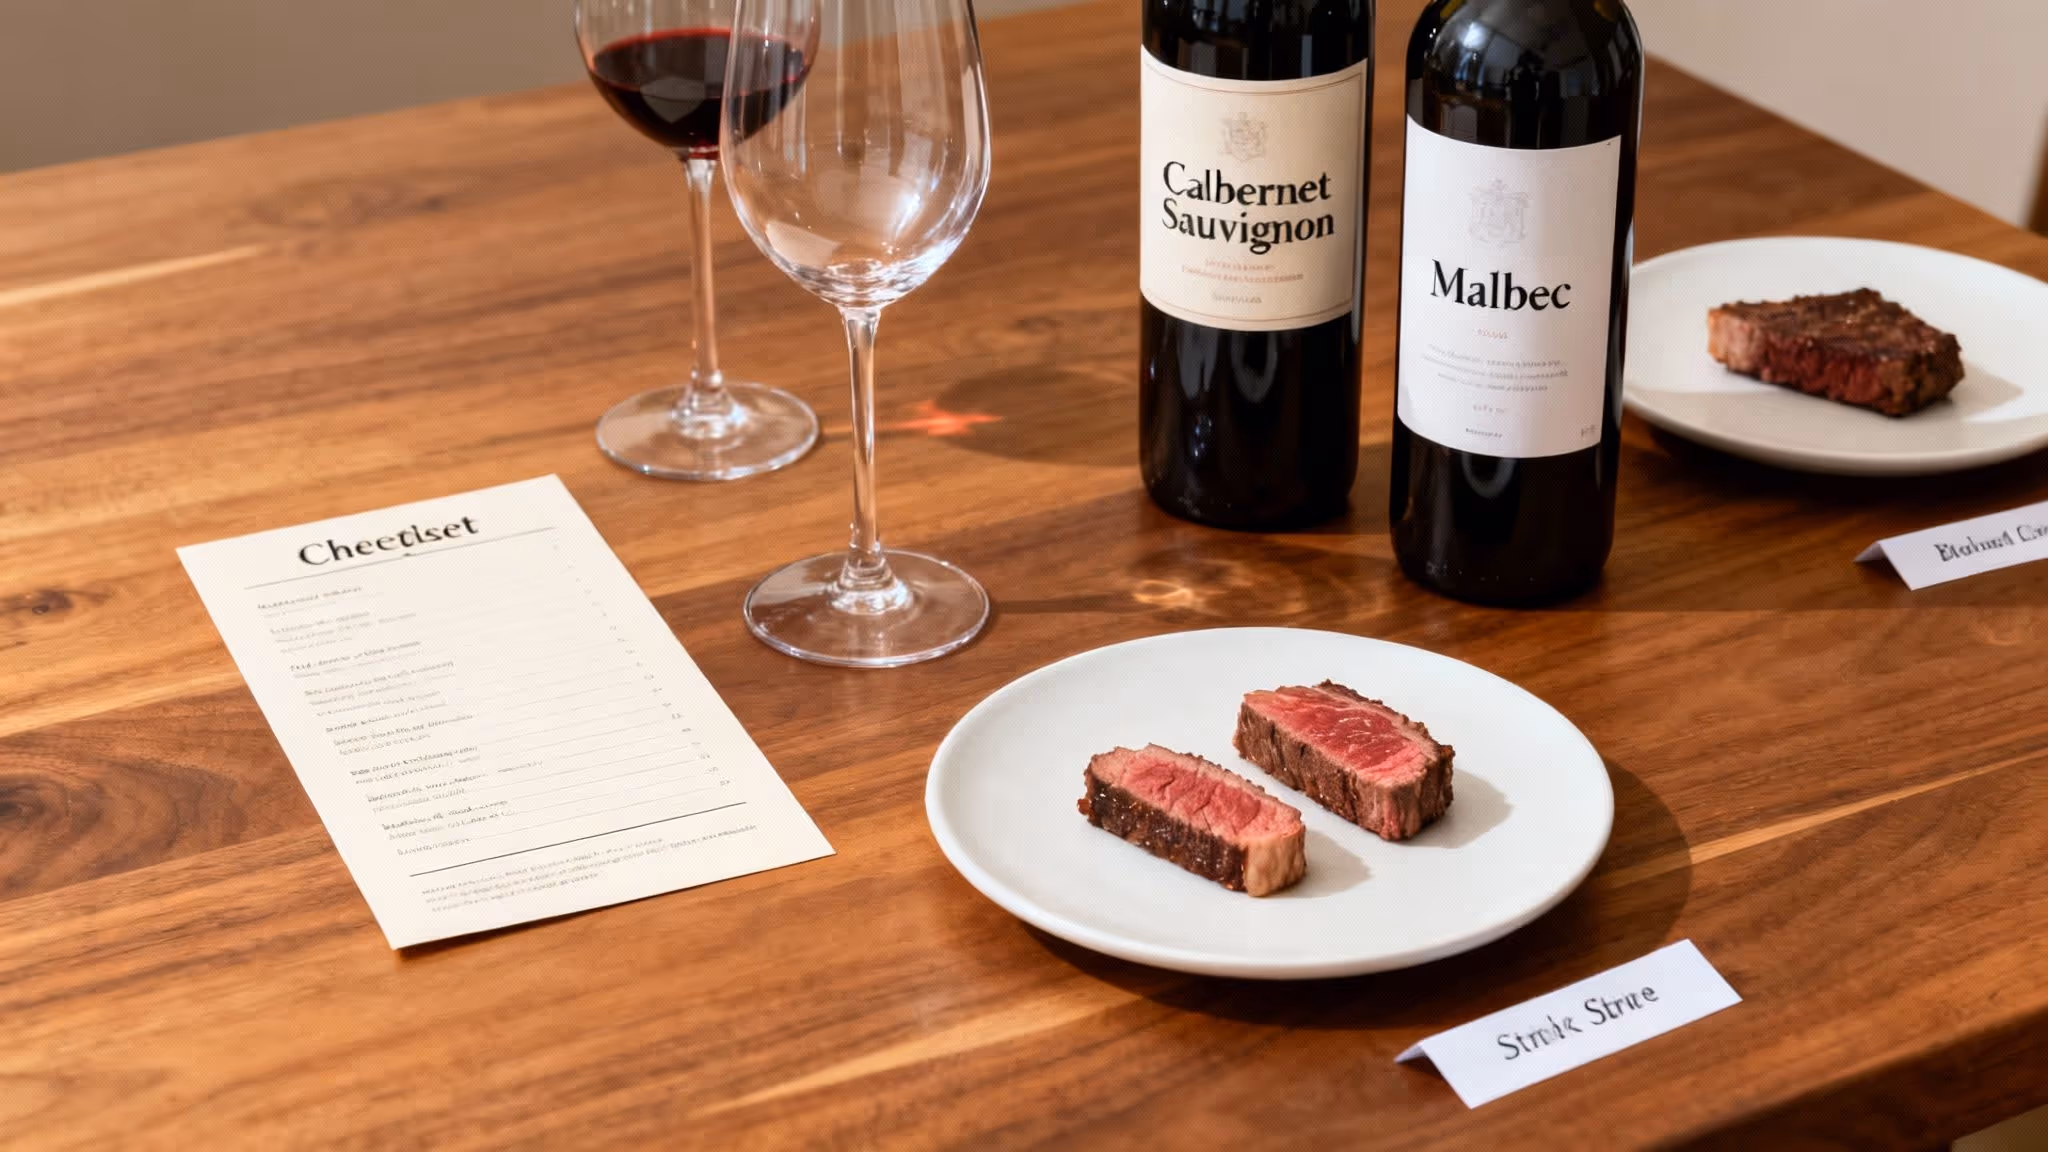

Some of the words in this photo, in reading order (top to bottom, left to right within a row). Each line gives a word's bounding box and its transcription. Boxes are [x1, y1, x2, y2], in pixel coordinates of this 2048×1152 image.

[1163, 161, 1332, 206] Calbernet
[1162, 197, 1335, 255] Sauvignon
[1430, 259, 1572, 311] Malbec
